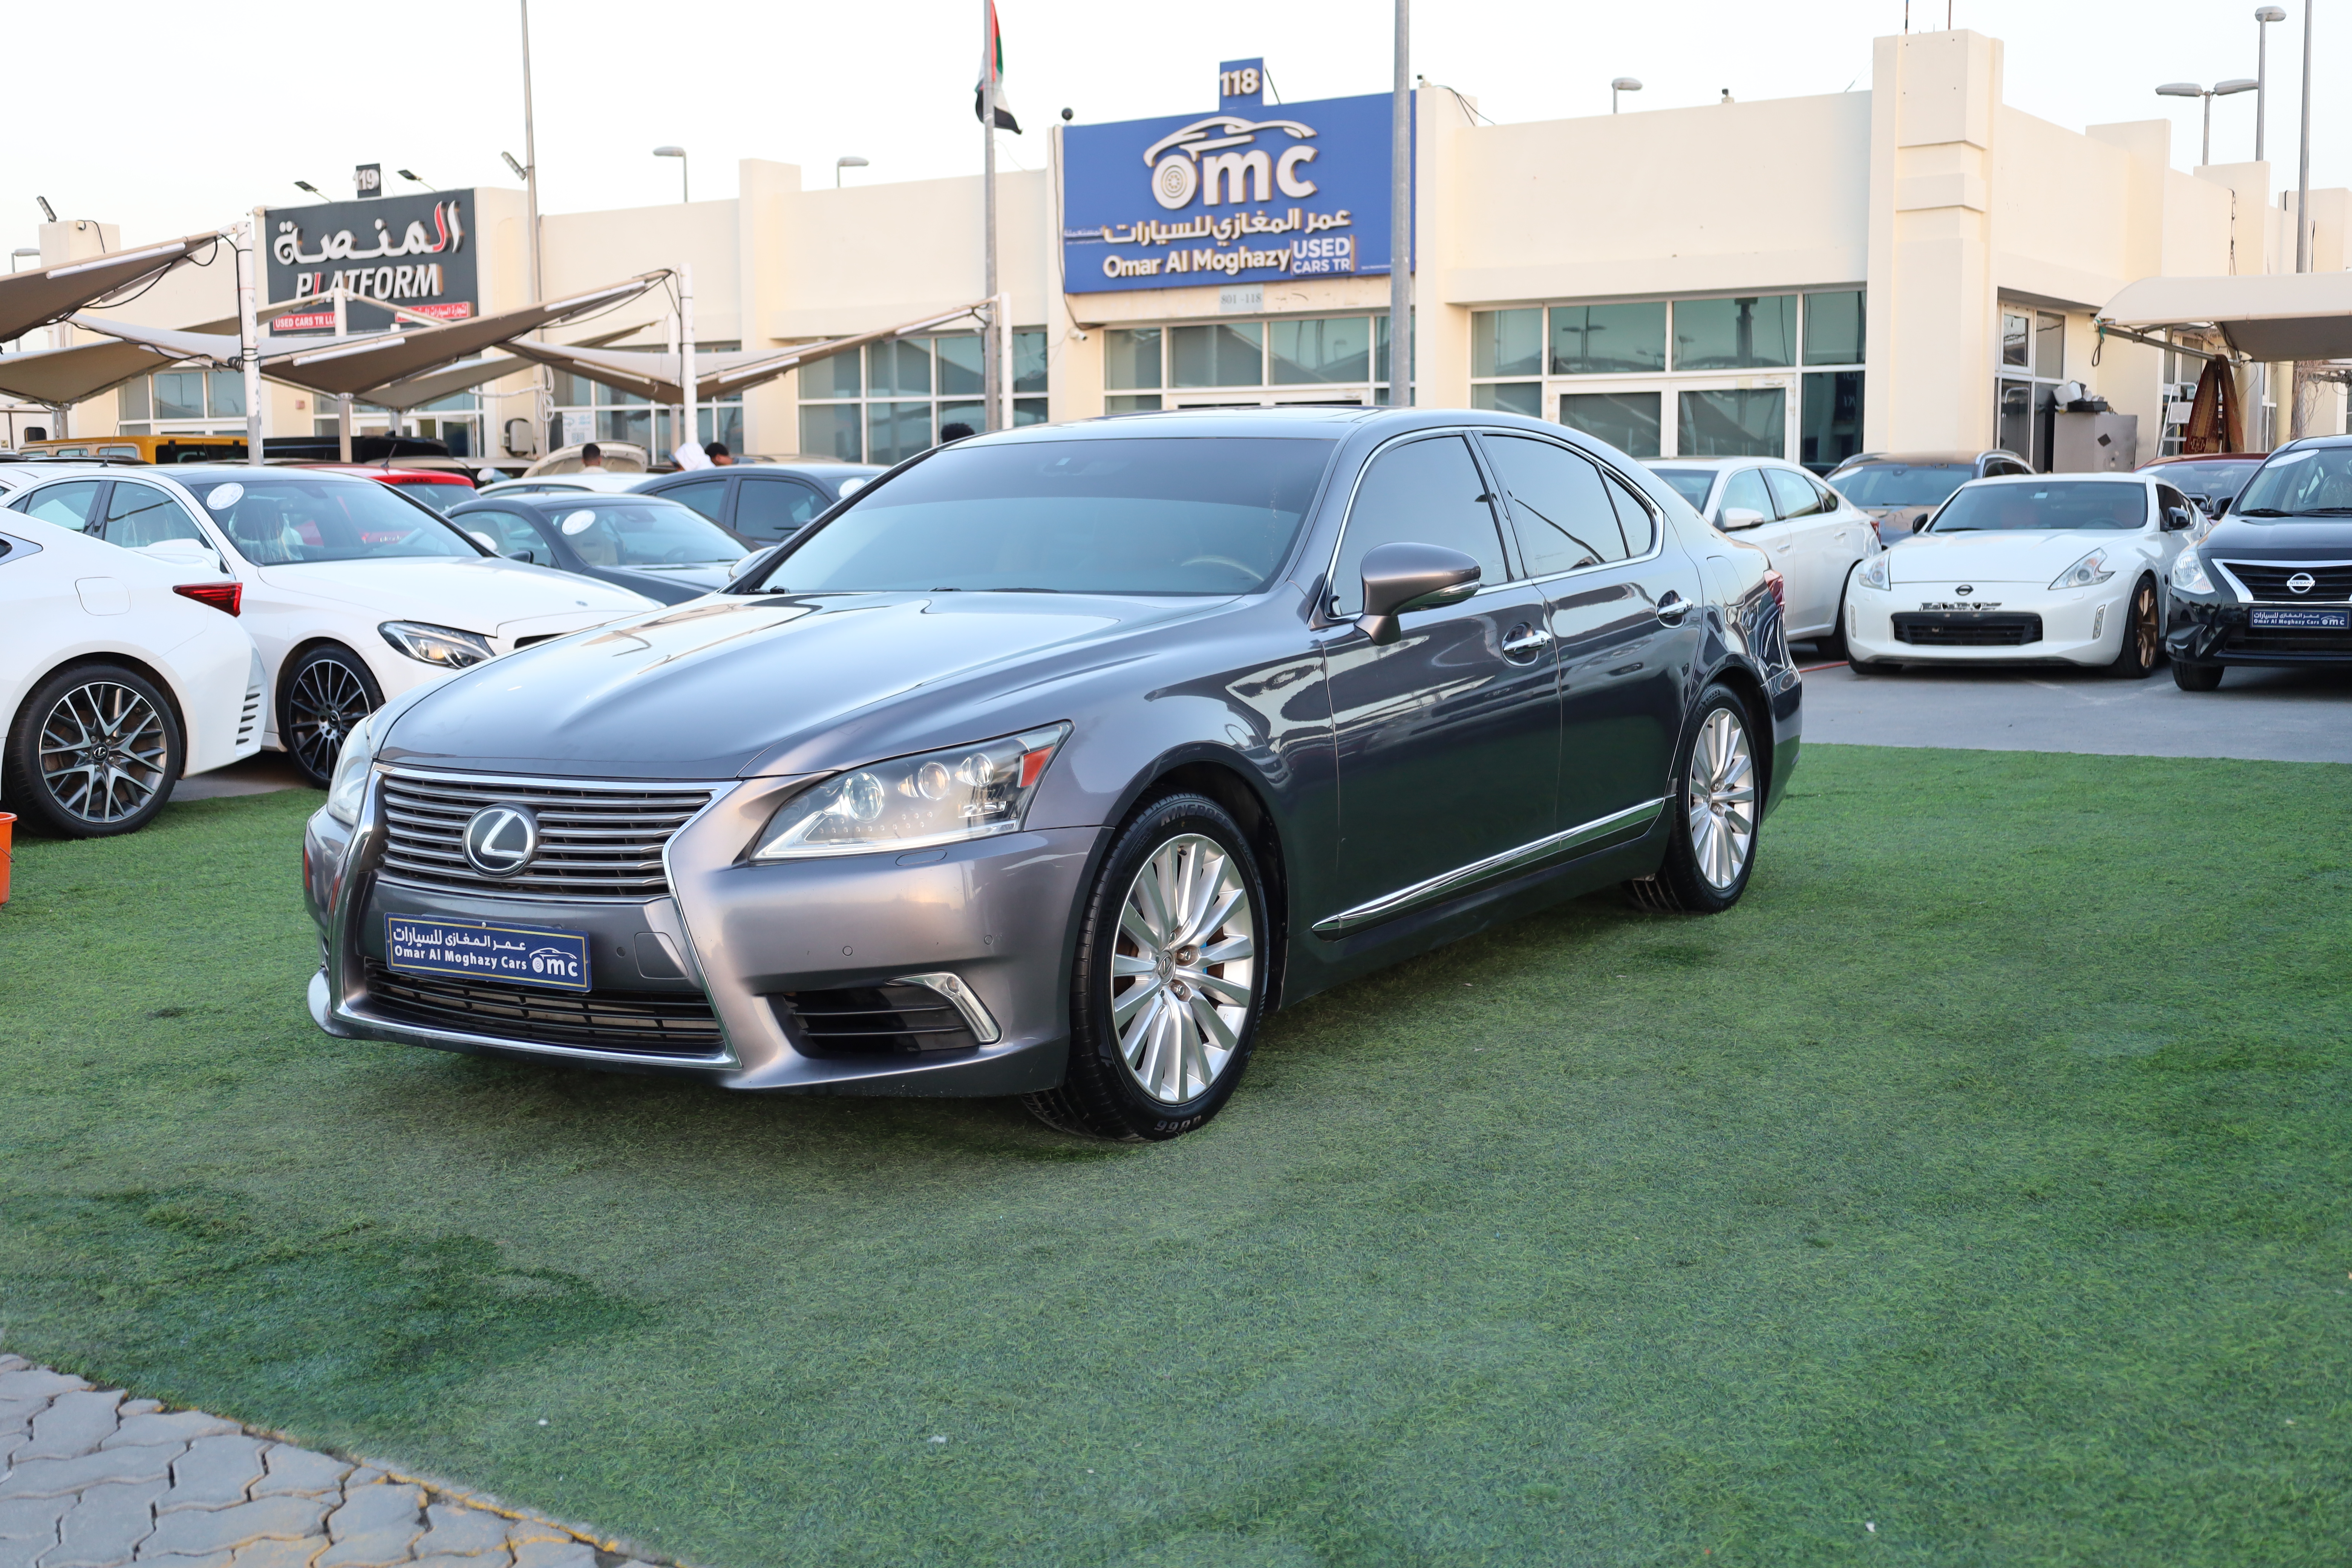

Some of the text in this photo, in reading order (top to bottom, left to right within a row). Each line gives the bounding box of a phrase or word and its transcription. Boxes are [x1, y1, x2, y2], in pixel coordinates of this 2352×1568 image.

[1220, 67, 1260, 97] 118
[353, 169, 379, 190] 119
[274, 200, 461, 265] المنصة
[1103, 215, 1213, 247] للسيارات
[1212, 207, 1302, 247] المغازي
[1305, 210, 1352, 234] عمر
[1293, 237, 1351, 259] USED
[1102, 246, 1292, 278] Omar Al Moghazy
[1293, 259, 1330, 273] CARS
[1332, 258, 1351, 271] TR
[276, 317, 293, 328] USED
[295, 316, 313, 326] CARS
[314, 315, 323, 325] TR
[393, 926, 443, 948] للسيارات
[492, 940, 526, 951] عمر
[394, 945, 527, 970] Omar Al Moghazy Cars
